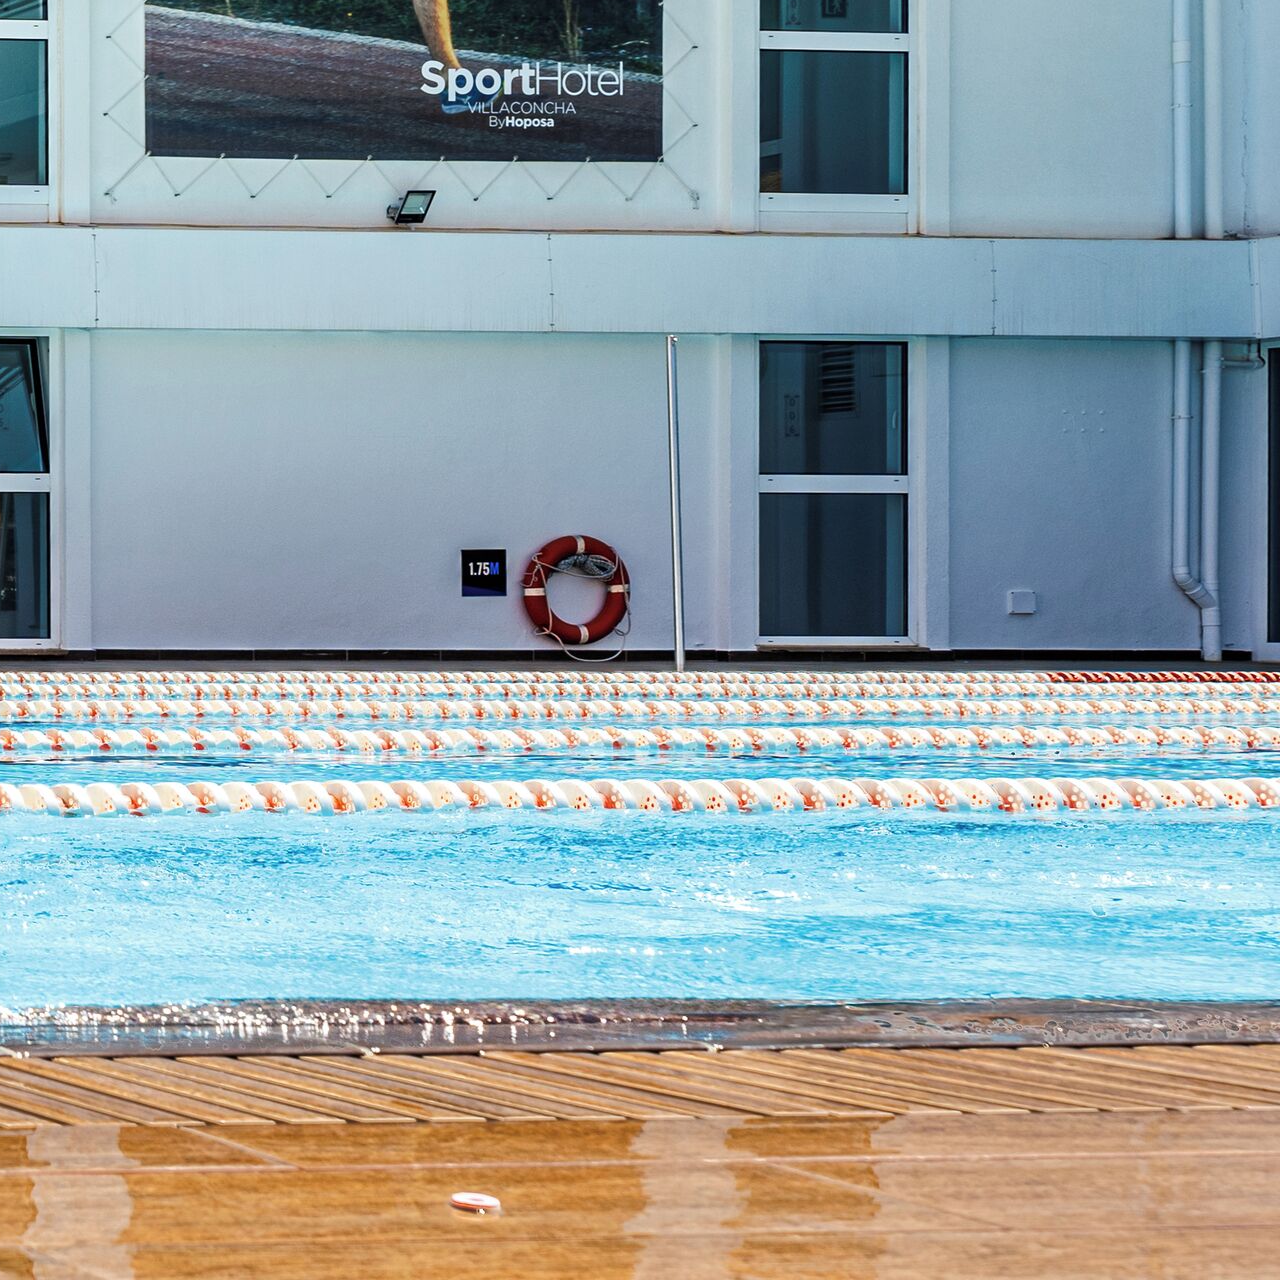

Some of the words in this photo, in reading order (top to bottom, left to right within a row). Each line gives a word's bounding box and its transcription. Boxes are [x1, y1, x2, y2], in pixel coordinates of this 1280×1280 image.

[420, 60, 624, 101] SportHotel
[467, 101, 577, 115] VILLACONCHA
[488, 115, 555, 129] ByHoposa
[468, 562, 500, 576] 1.75M
